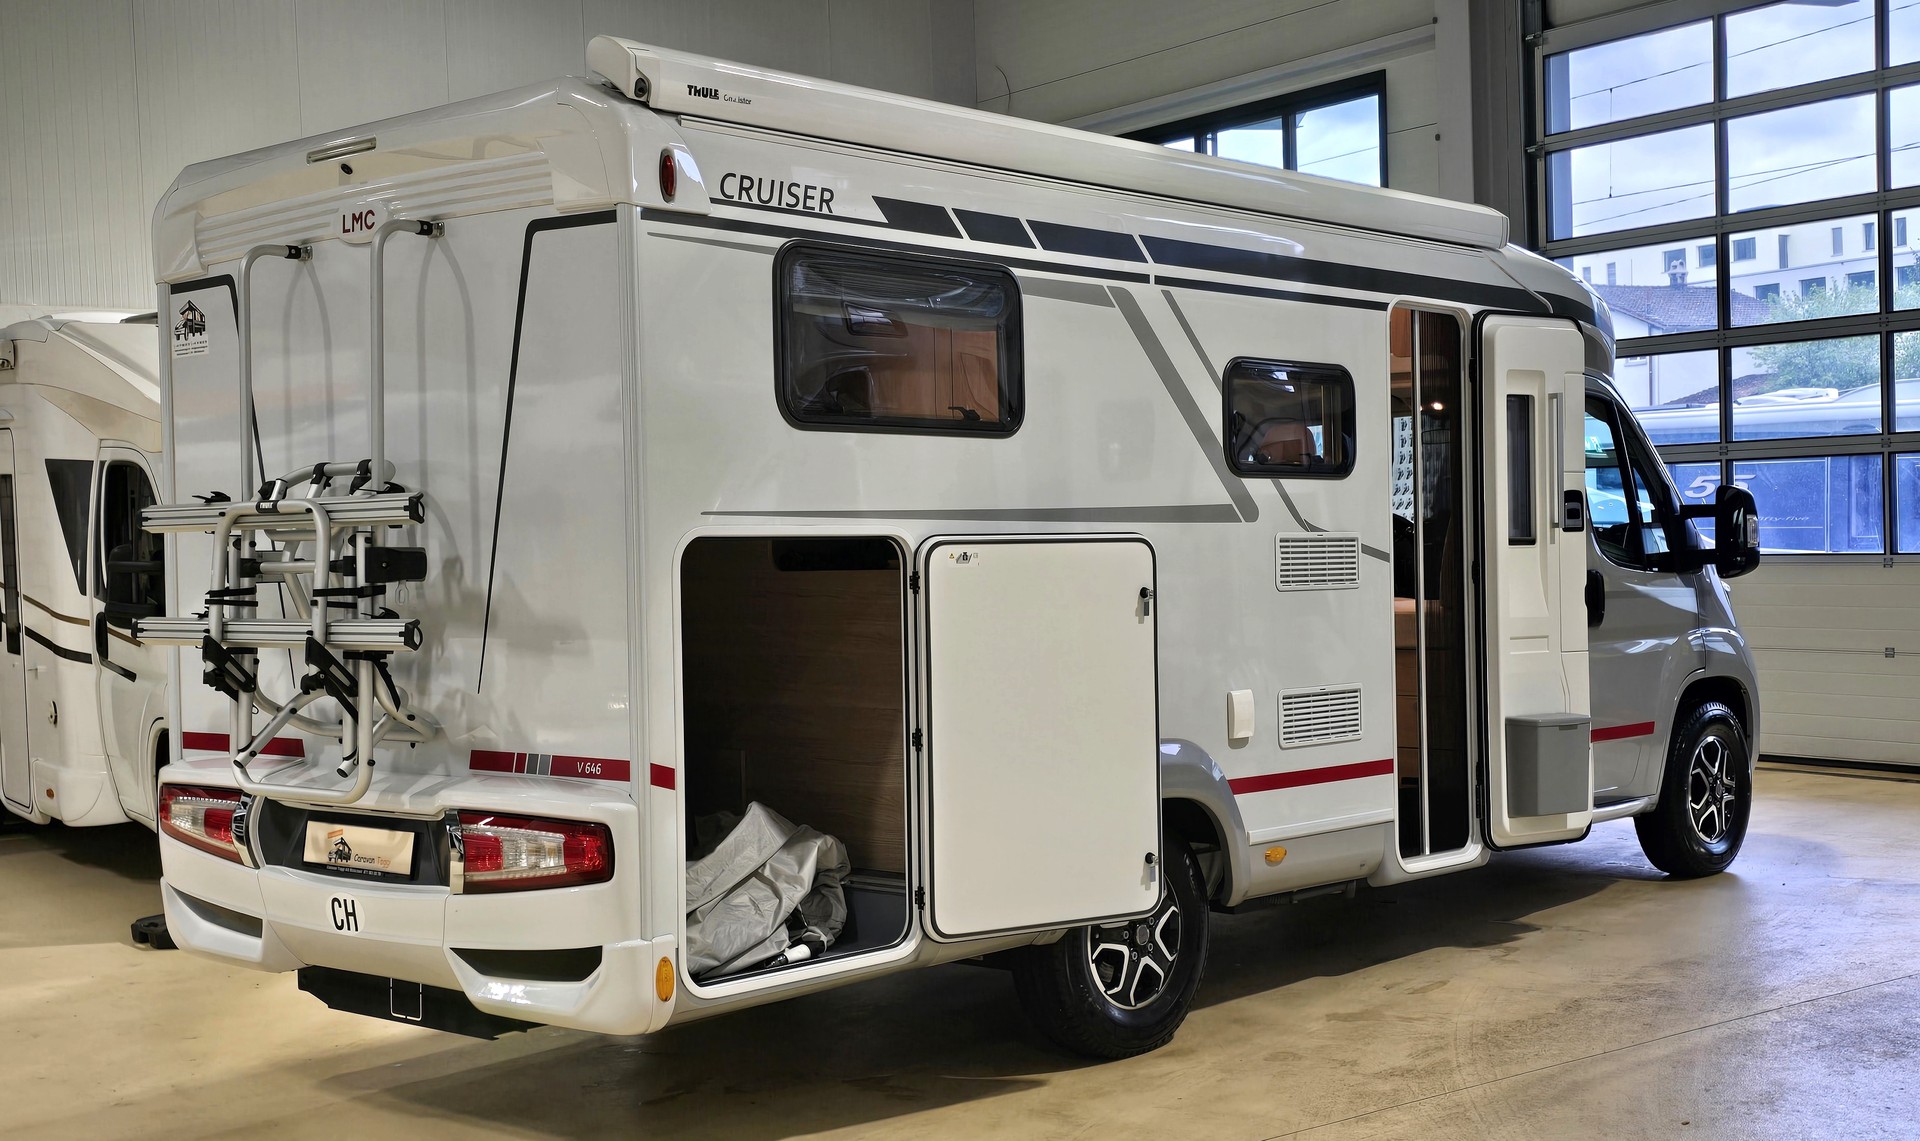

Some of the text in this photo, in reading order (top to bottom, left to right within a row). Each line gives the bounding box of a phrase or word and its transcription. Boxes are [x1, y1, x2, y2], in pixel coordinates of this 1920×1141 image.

[687, 84, 720, 100] THULE
[720, 172, 835, 214] CRUISER
[342, 209, 376, 234] LMC
[577, 761, 602, 775] V 646
[354, 853, 376, 865] Caravan
[331, 896, 359, 932] CH
